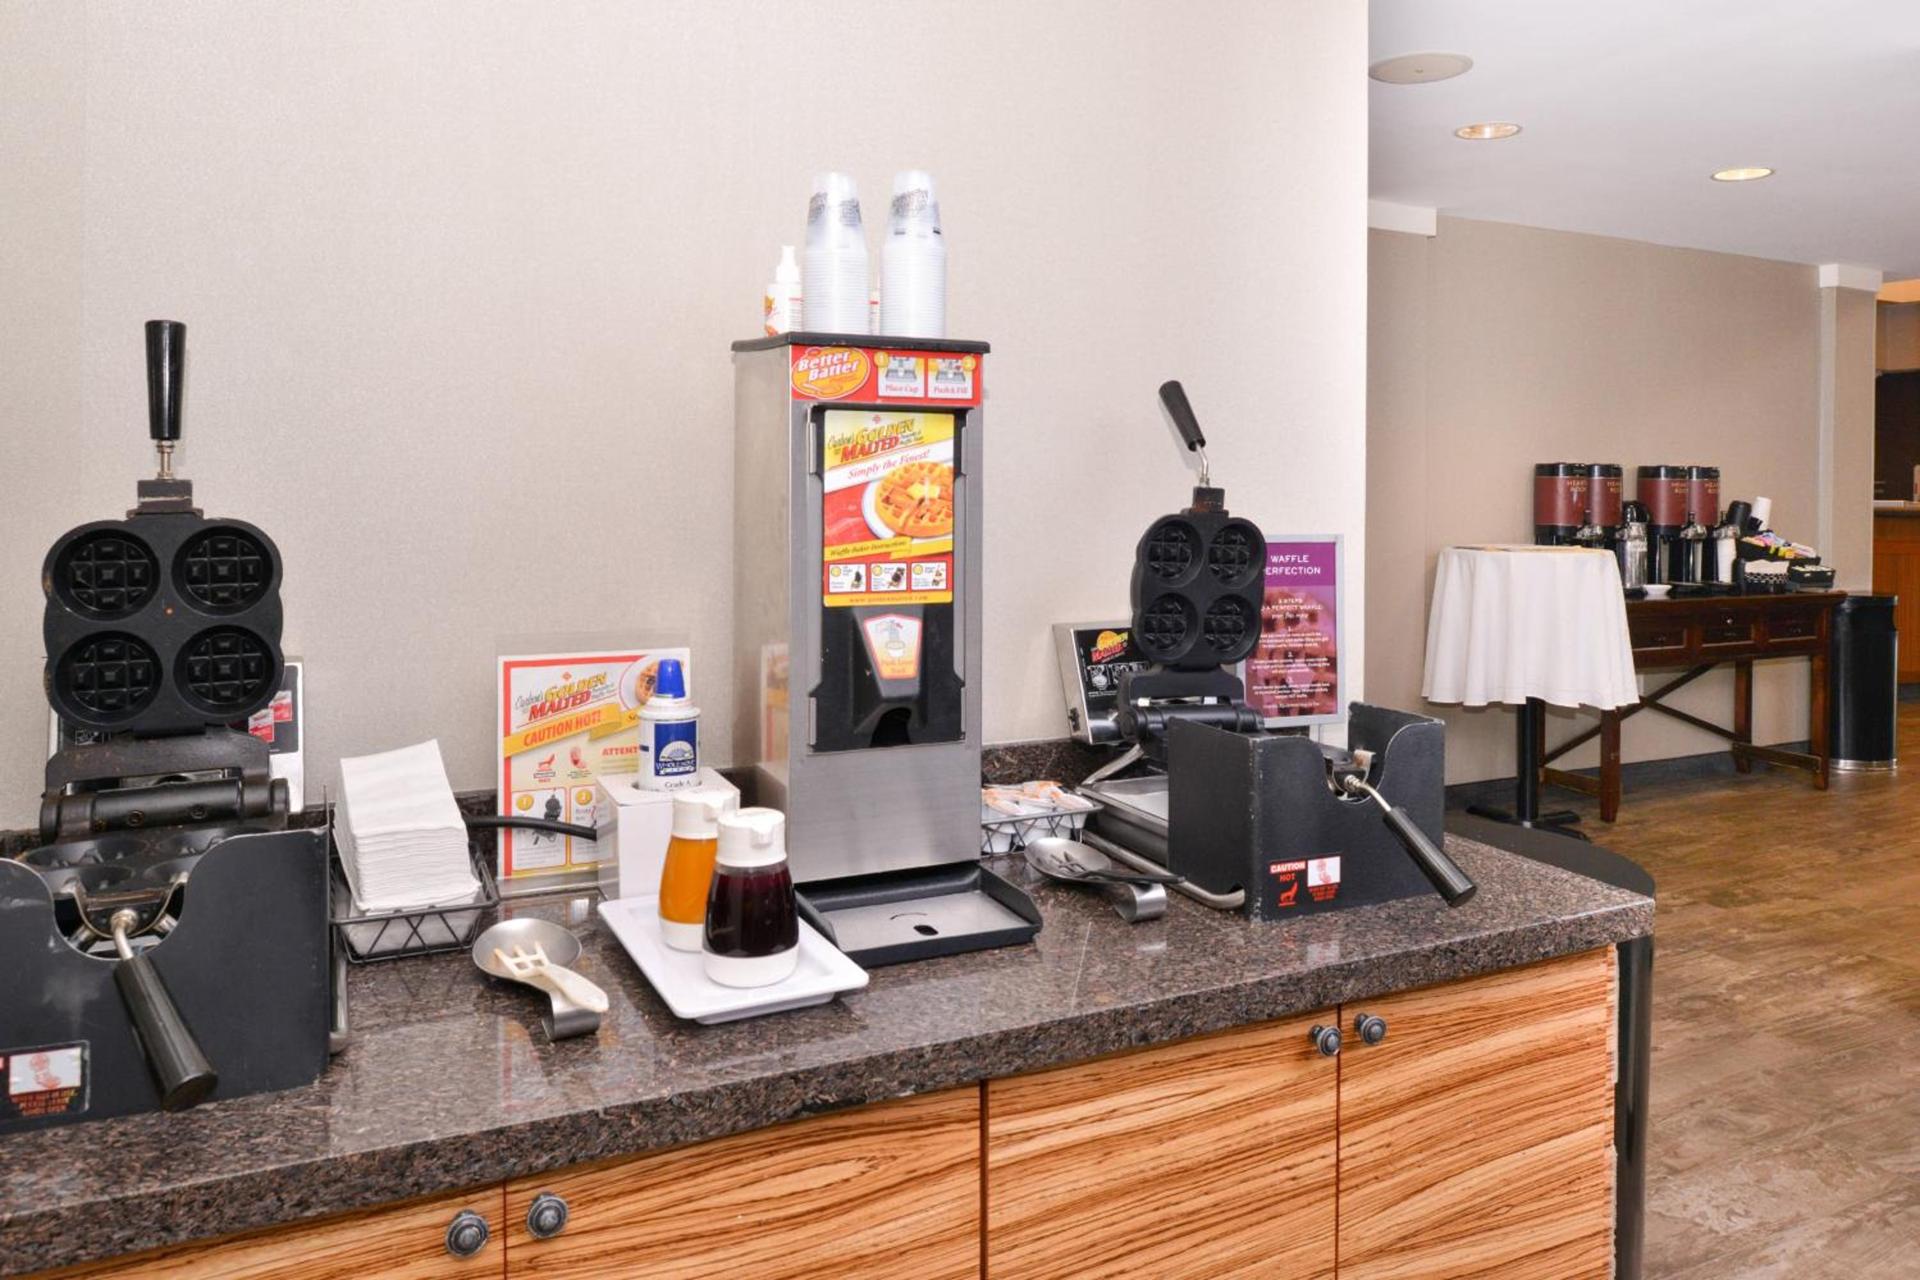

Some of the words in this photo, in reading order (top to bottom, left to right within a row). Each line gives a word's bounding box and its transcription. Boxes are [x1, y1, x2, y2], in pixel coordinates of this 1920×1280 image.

[798, 350, 851, 372] Better
[808, 360, 860, 381] Batter
[855, 419, 915, 446] GOLDEN
[840, 435, 901, 462] MALTED
[848, 463, 882, 479] Simply
[882, 458, 898, 470] the
[1270, 554, 1310, 563] WAFFLE
[1265, 566, 1321, 576] ERFECTION
[544, 672, 608, 702] GOLDEN
[528, 690, 593, 721] MALTED
[523, 719, 574, 747] CAUTION
[575, 709, 602, 730] HOT!
[602, 745, 638, 756] ATTENT
[1270, 860, 1306, 873] CAUTION
